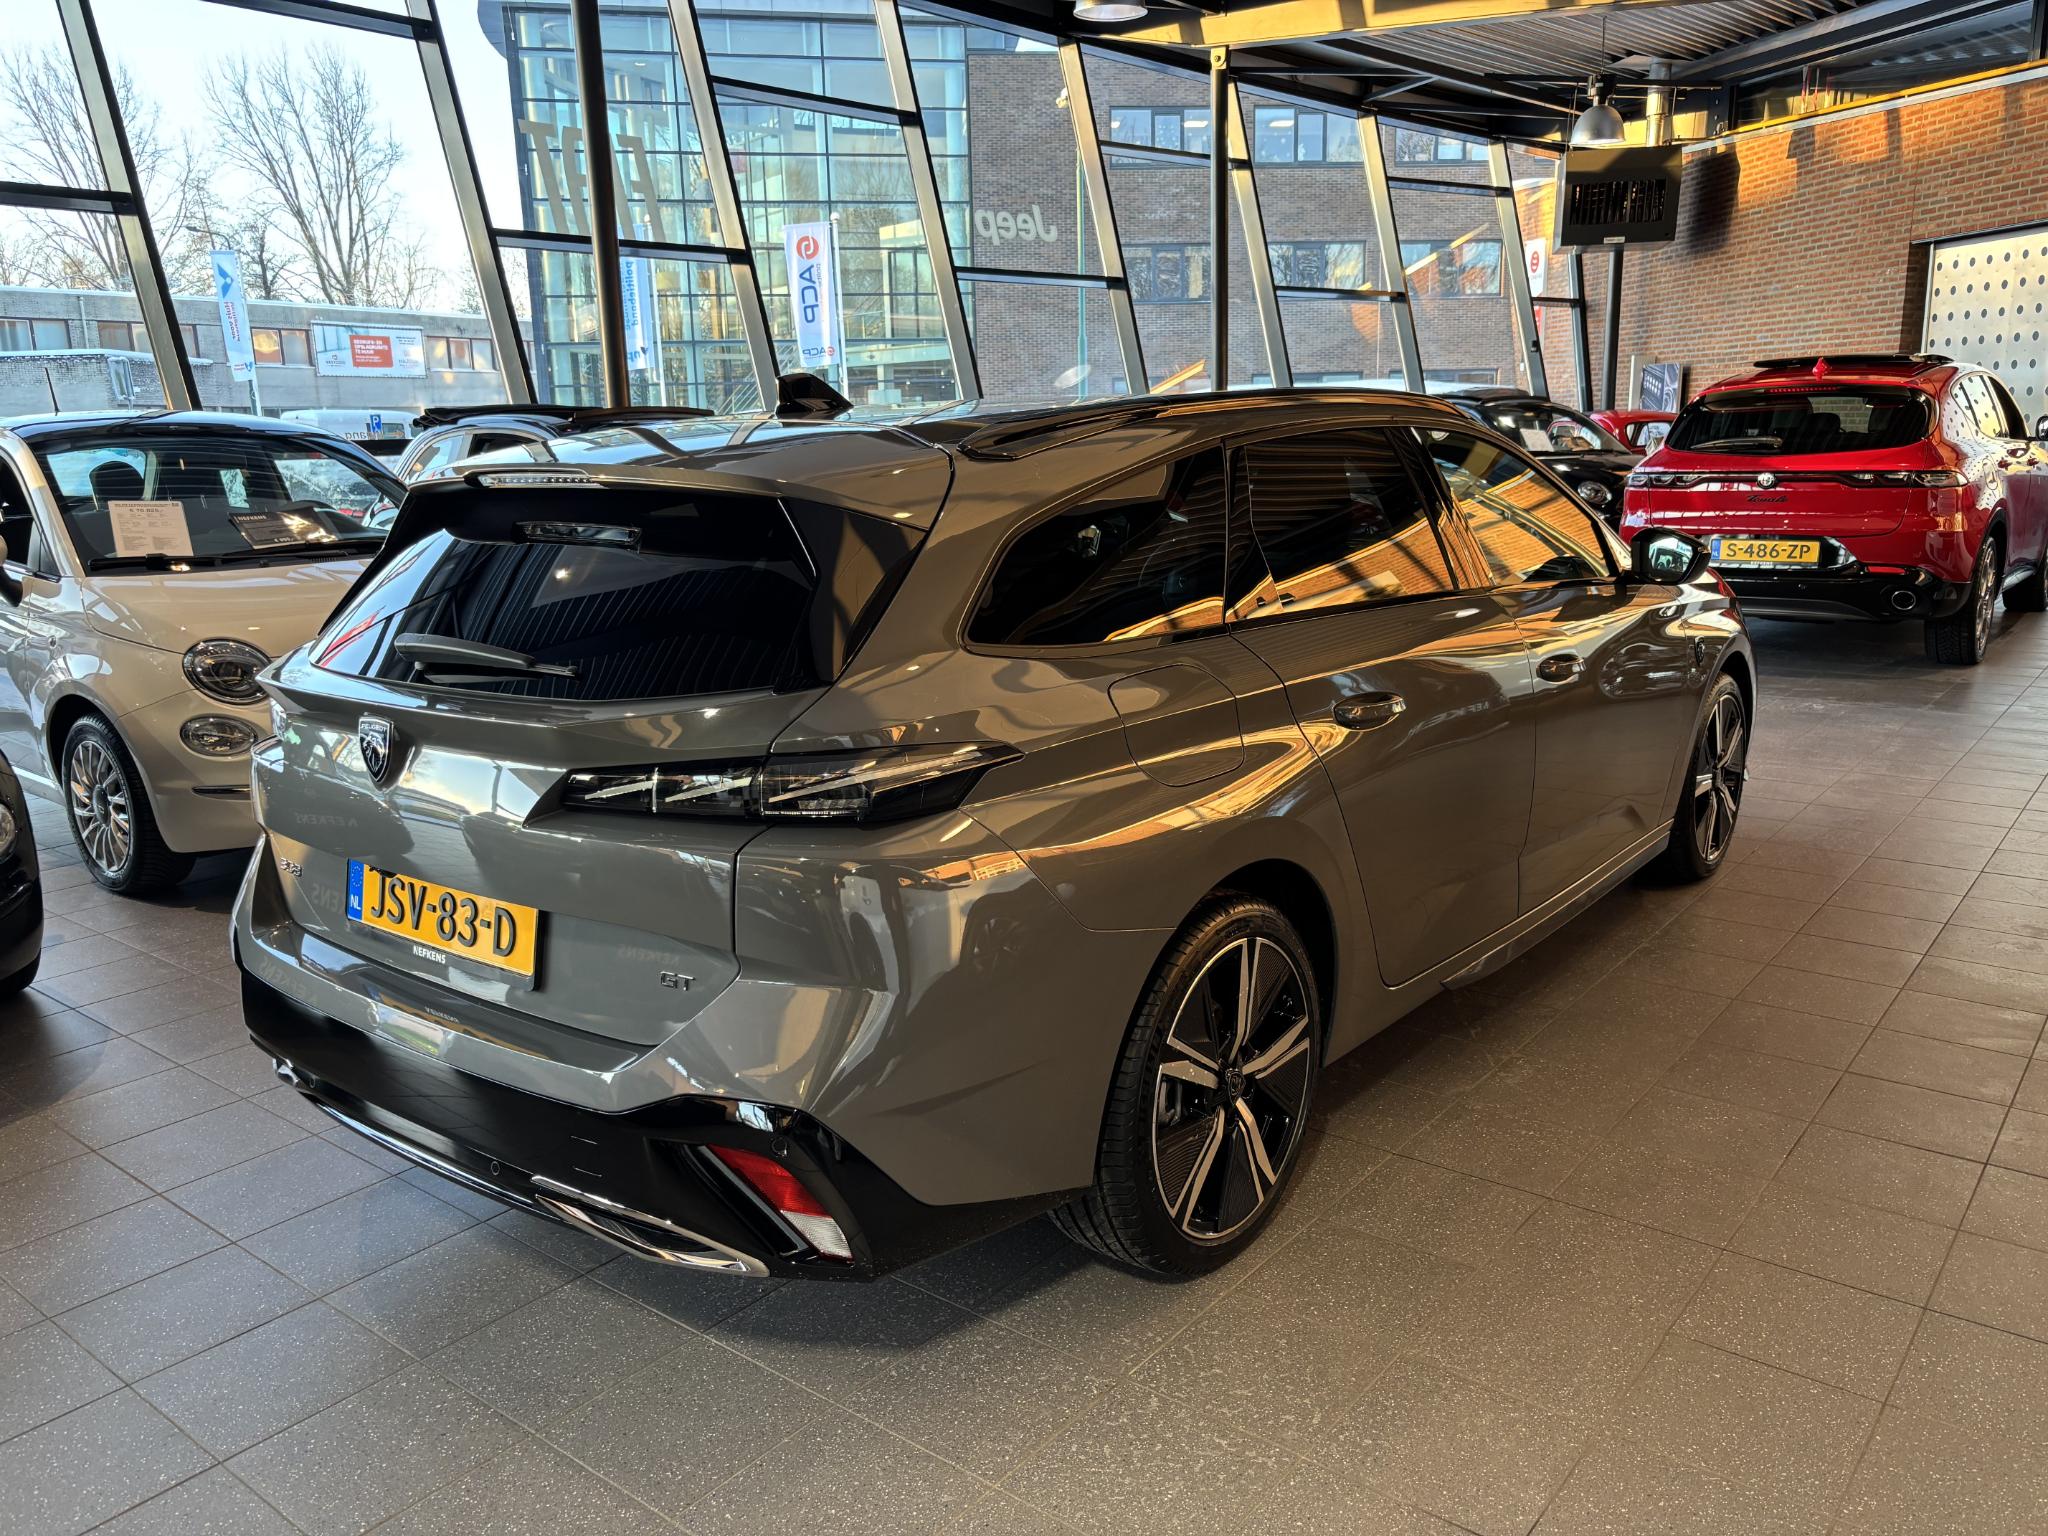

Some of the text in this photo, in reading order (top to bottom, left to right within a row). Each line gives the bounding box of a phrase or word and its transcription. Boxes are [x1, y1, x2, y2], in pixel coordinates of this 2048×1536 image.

[372, 415, 380, 427] P
[1726, 543, 1811, 559] S-486-ZP
[360, 723, 388, 732] PEUGEOT
[350, 894, 362, 910] NL
[370, 874, 517, 958] JSV-83-D
[413, 945, 446, 965] NEFKENS
[660, 971, 696, 991] GT
